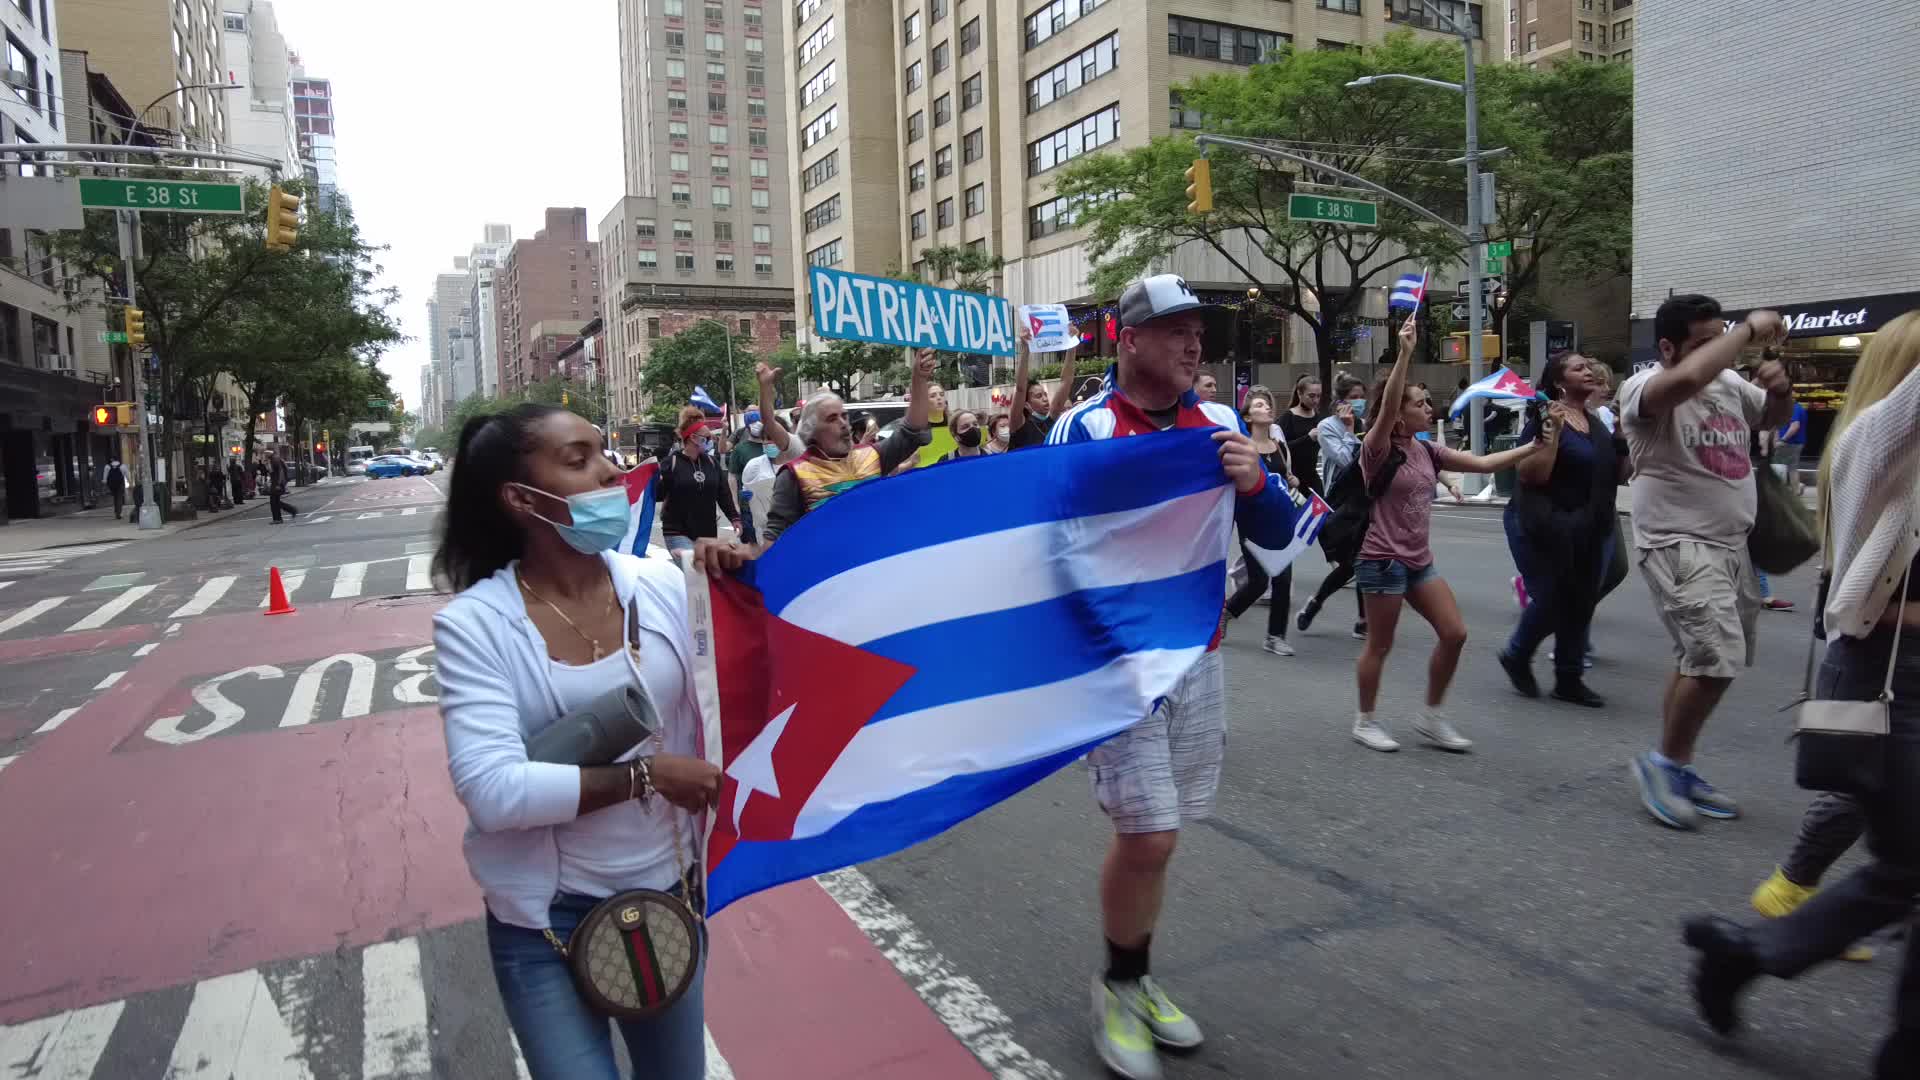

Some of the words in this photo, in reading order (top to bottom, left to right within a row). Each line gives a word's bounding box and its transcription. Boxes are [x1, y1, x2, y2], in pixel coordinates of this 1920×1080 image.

[126, 185, 137, 203] E
[146, 186, 170, 205] 38
[179, 187, 199, 206] St
[1317, 201, 1325, 217] E
[1327, 202, 1341, 218] 38
[1343, 204, 1354, 219] St
[1782, 308, 1869, 331] Market
[144, 644, 441, 745] BUS
